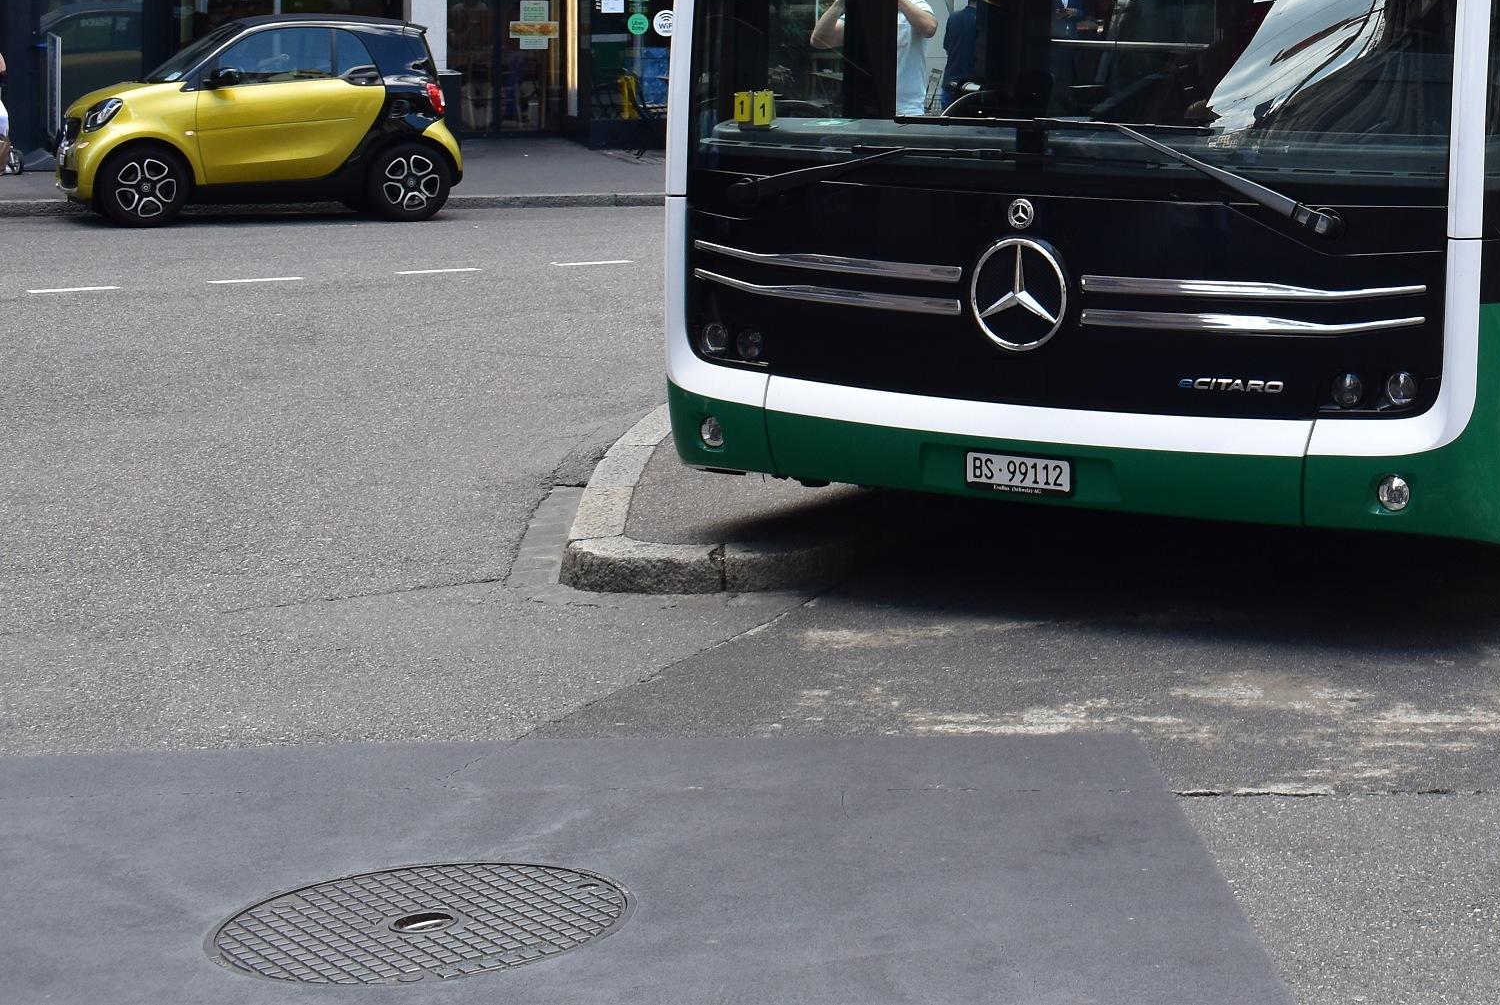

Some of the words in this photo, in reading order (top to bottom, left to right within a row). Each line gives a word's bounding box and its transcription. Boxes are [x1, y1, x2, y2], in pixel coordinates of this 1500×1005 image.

[739, 100, 745, 115] 1
[759, 103, 766, 118] 1
[1178, 378, 1284, 394] eCITARO
